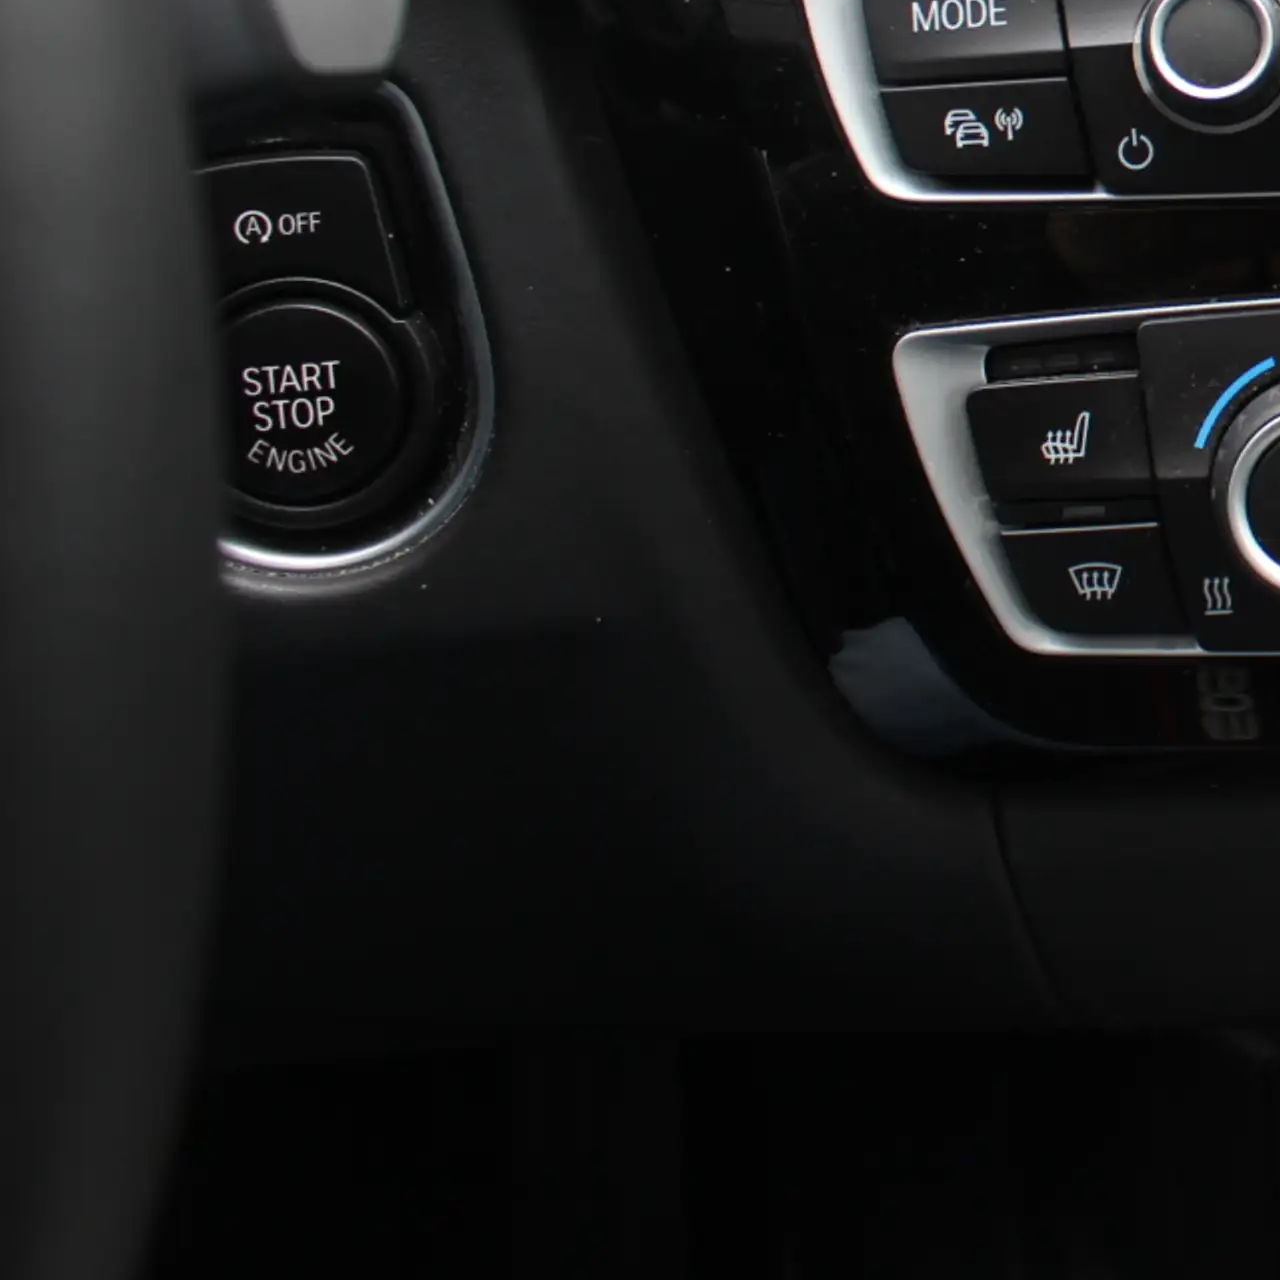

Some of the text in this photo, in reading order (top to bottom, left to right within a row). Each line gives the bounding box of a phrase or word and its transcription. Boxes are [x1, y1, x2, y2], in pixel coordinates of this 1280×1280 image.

[278, 211, 321, 236] OFF
[242, 360, 340, 397] START
[253, 397, 335, 432] STOP
[247, 432, 355, 474] ENGINE
